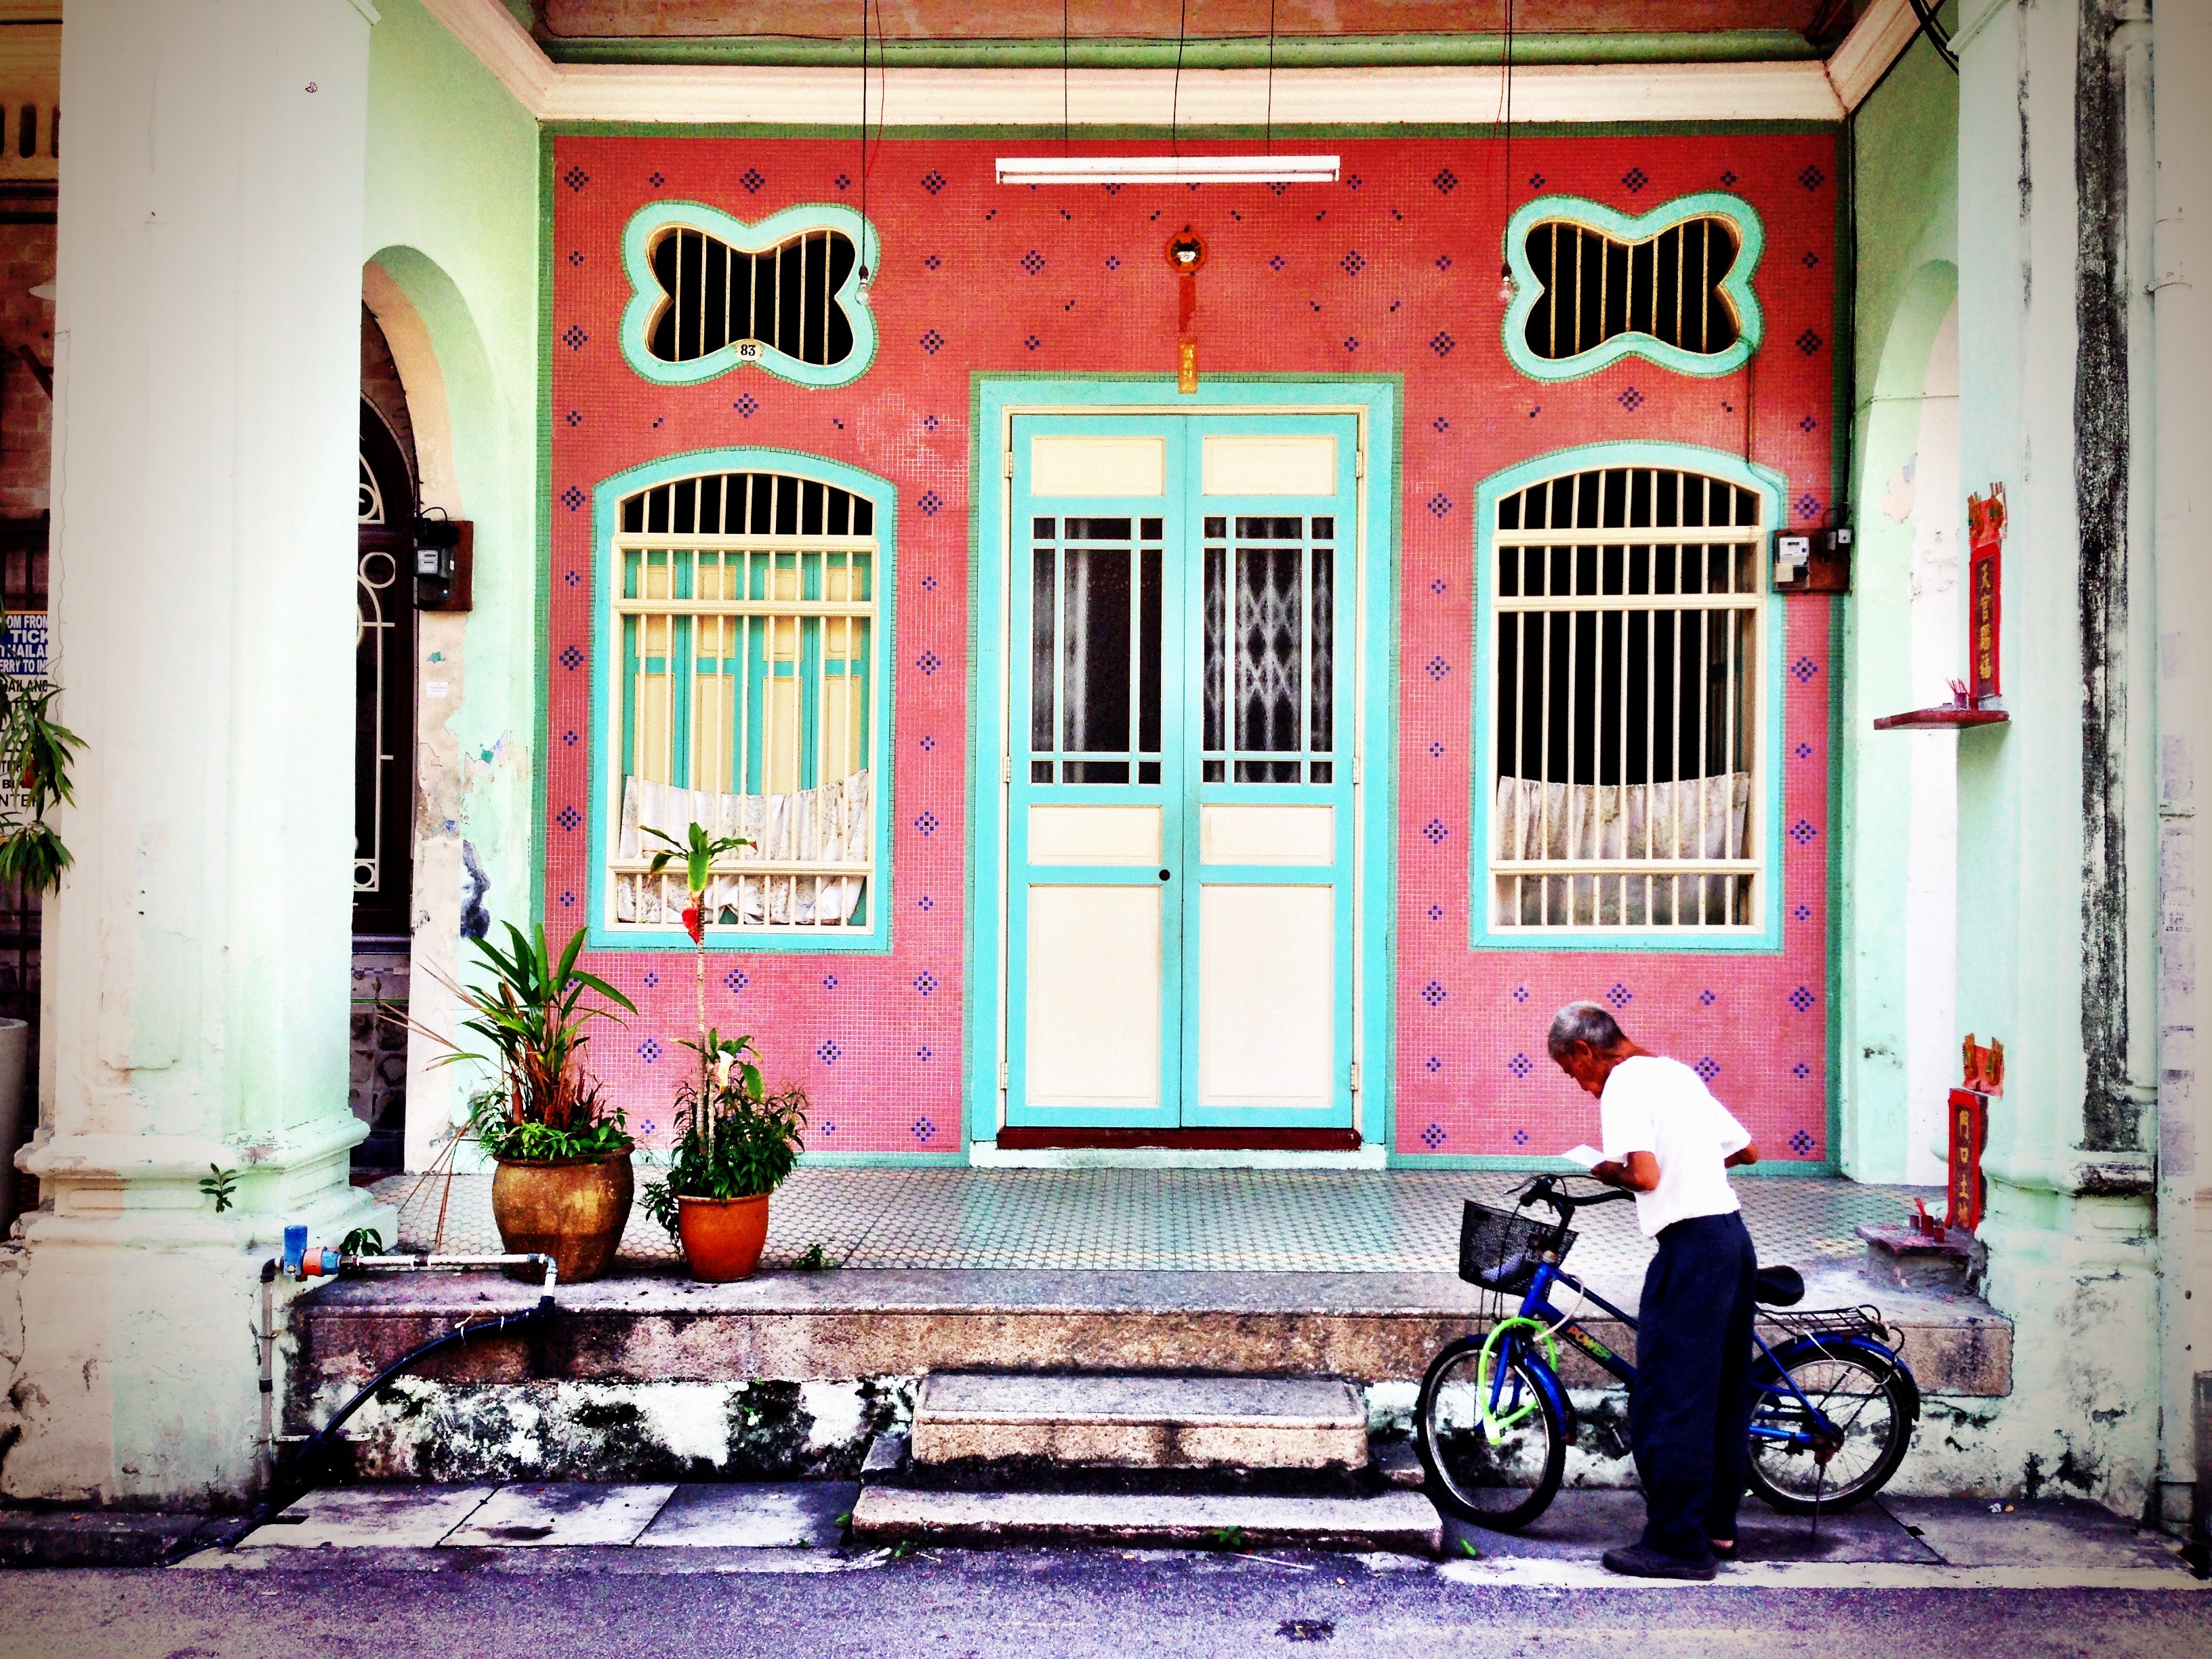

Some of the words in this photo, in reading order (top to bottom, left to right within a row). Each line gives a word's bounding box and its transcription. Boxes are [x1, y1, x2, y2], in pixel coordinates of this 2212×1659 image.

[740, 344, 756, 356] 83
[5, 615, 22, 629] OM
[22, 659, 35, 673] TO
